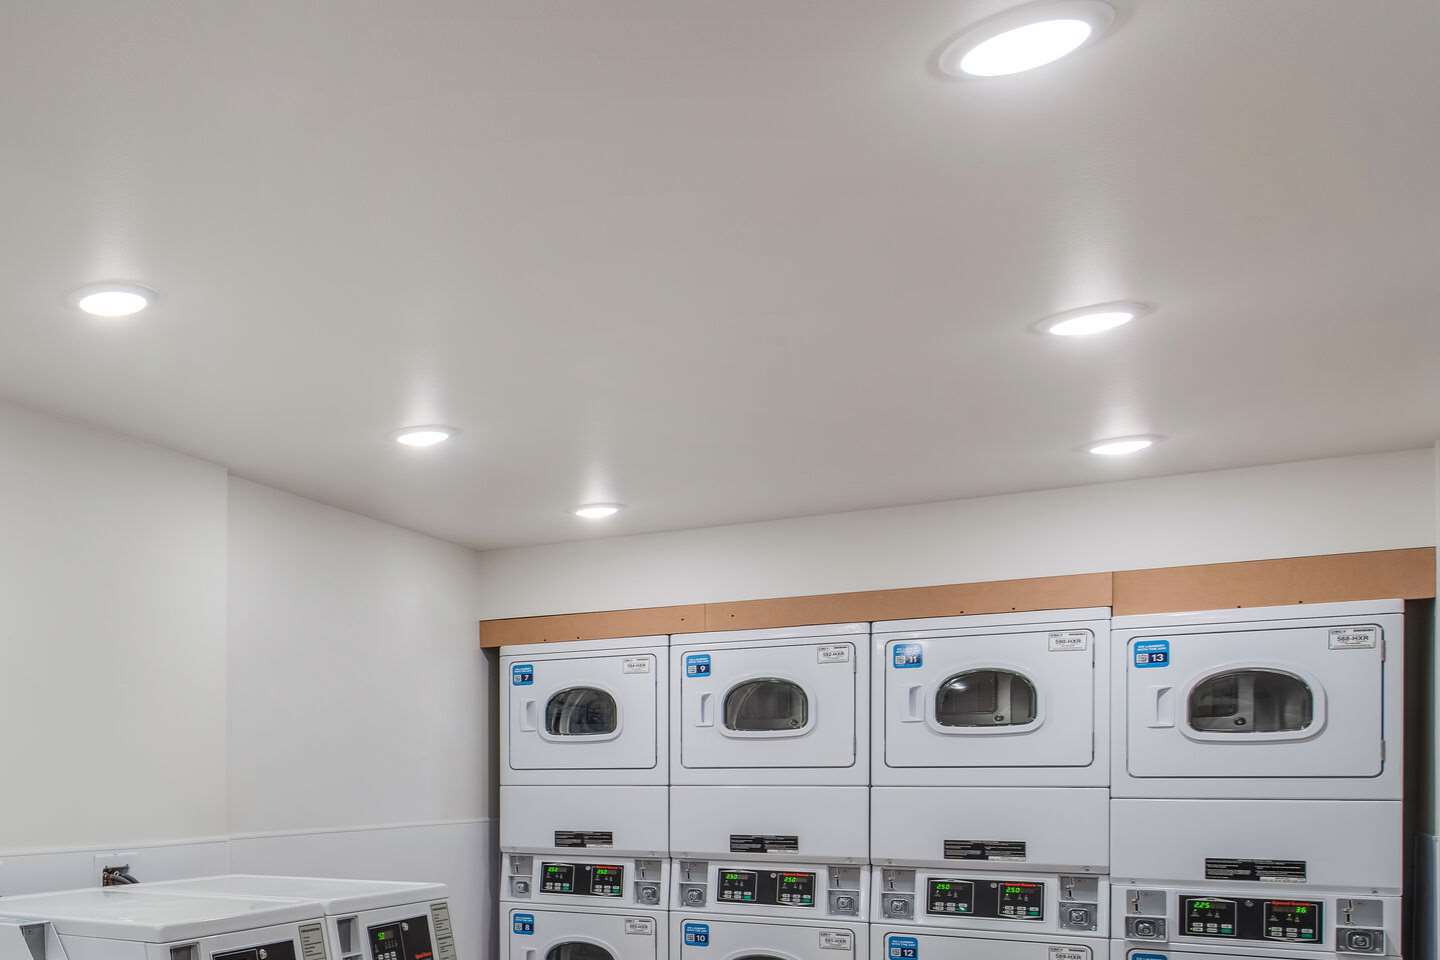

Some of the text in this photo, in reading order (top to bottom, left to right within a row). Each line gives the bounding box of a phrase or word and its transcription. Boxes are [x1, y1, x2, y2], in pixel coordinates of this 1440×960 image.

[1151, 653, 1164, 662] 13
[700, 665, 706, 673] 9
[695, 934, 706, 942] 10
[903, 949, 914, 957] 12
